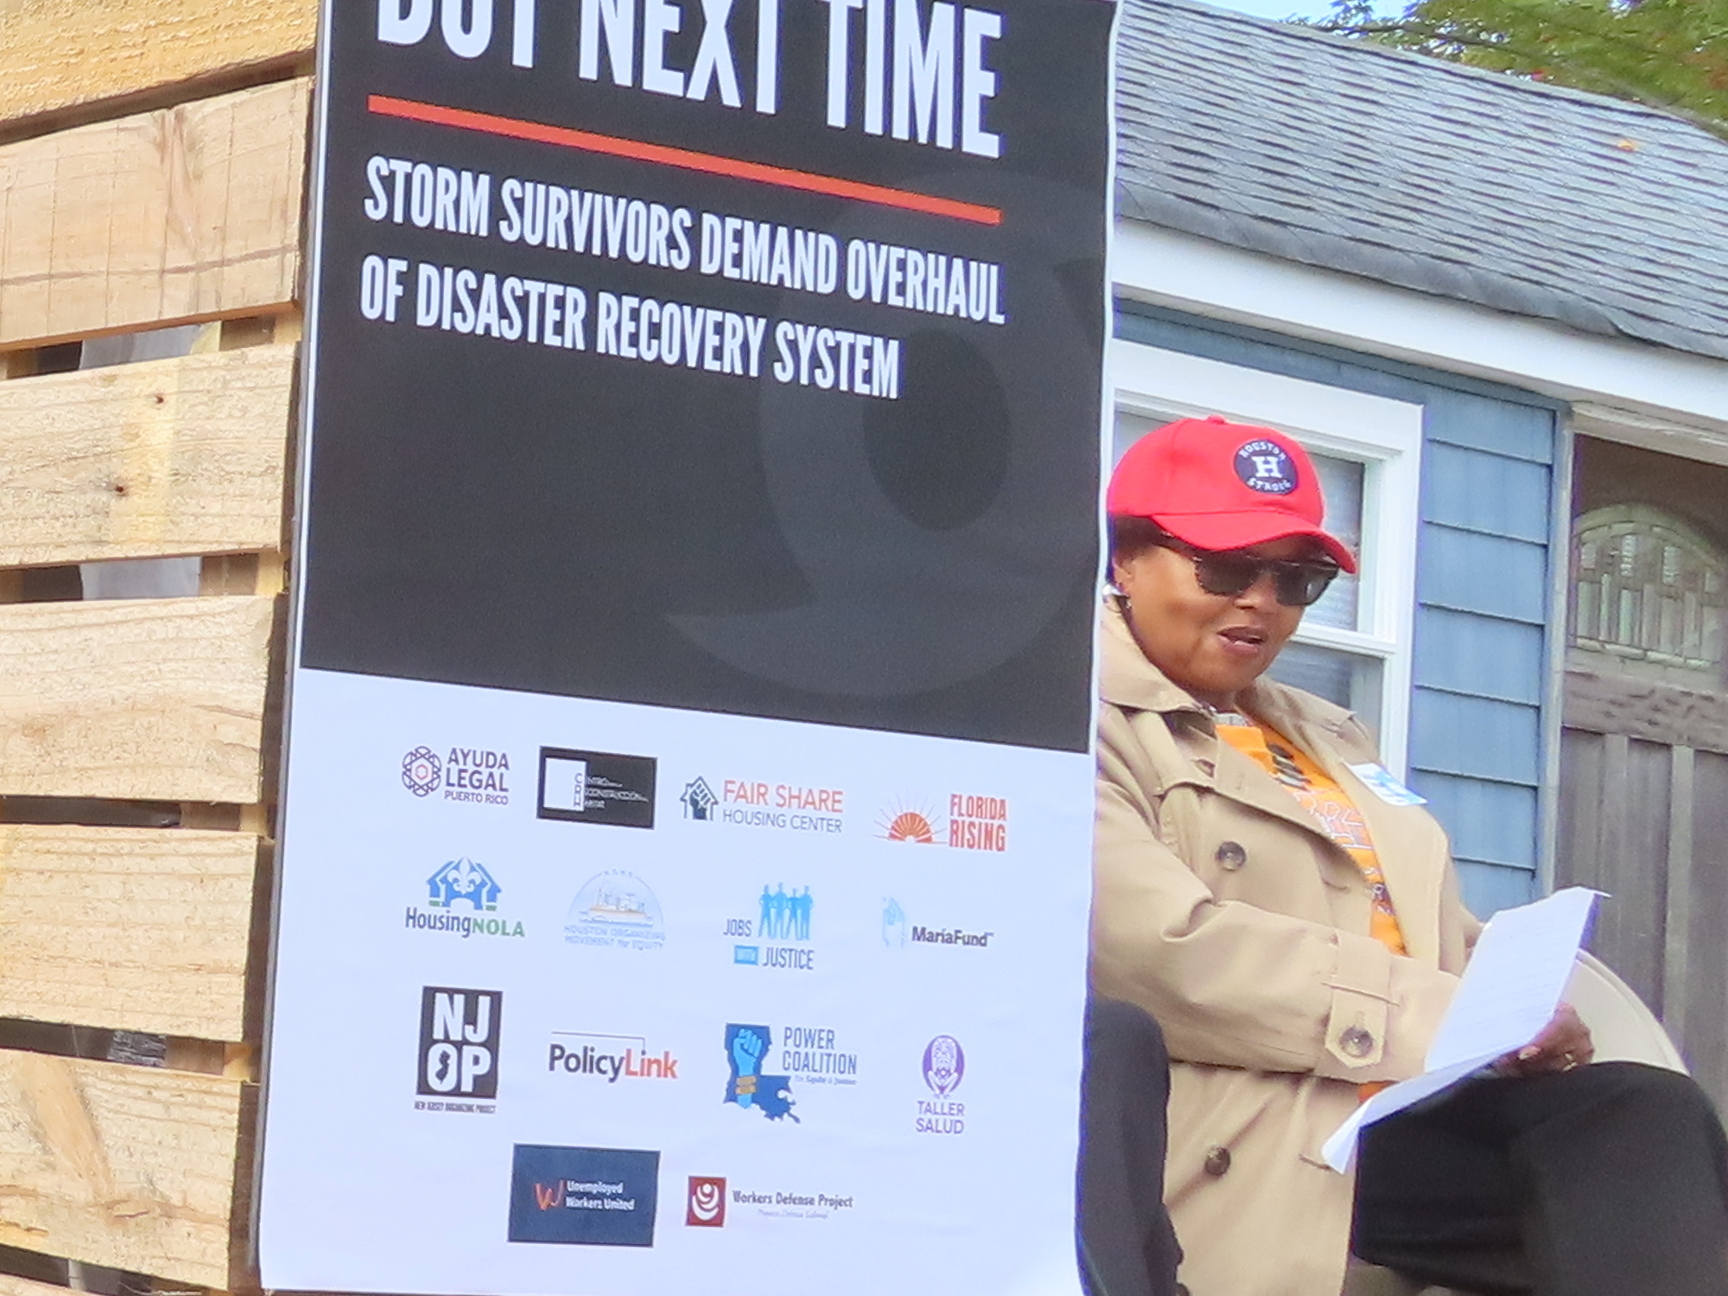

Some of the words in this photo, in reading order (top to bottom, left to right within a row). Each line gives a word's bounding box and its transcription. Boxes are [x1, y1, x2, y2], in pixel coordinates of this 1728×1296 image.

[364, 155, 492, 238] STORM
[498, 176, 692, 273] SURVIVORS
[700, 211, 838, 295] DEMAND
[846, 238, 1006, 325] OVERHAUL
[360, 254, 408, 322] OF
[416, 262, 588, 353] DISASTER
[595, 292, 767, 379] RECOVERY
[772, 329, 900, 400] SYSTEM
[1239, 441, 1287, 461] HOUSTON
[1251, 455, 1283, 478] H
[447, 748, 509, 771] AYUDA
[445, 768, 509, 792] LEGAL
[444, 792, 483, 804] PUERTO
[485, 794, 509, 806] RICO
[723, 779, 769, 806] FAIR
[775, 783, 843, 813] SHARE
[949, 793, 1007, 821] FLORIDA
[722, 808, 786, 829] HOUSING
[790, 814, 843, 833] CENTER
[948, 821, 1007, 852] RISING
[405, 906, 525, 939] HousingNOLA
[723, 918, 752, 937] JOBS
[762, 946, 815, 970] JUSTICE
[432, 992, 491, 1043] NJ
[783, 1026, 835, 1050] POWER
[427, 1042, 492, 1092] OP
[548, 1042, 679, 1083] PolicyLink
[782, 1050, 858, 1075] COALITION
[916, 1100, 965, 1117] TALLER
[915, 1117, 965, 1135] SALUD
[567, 1180, 624, 1196] Unemployed
[732, 1190, 773, 1205] Workers
[775, 1191, 816, 1206] Defense
[818, 1193, 854, 1210] Project
[565, 1196, 603, 1210] Workers
[604, 1198, 636, 1211] United
